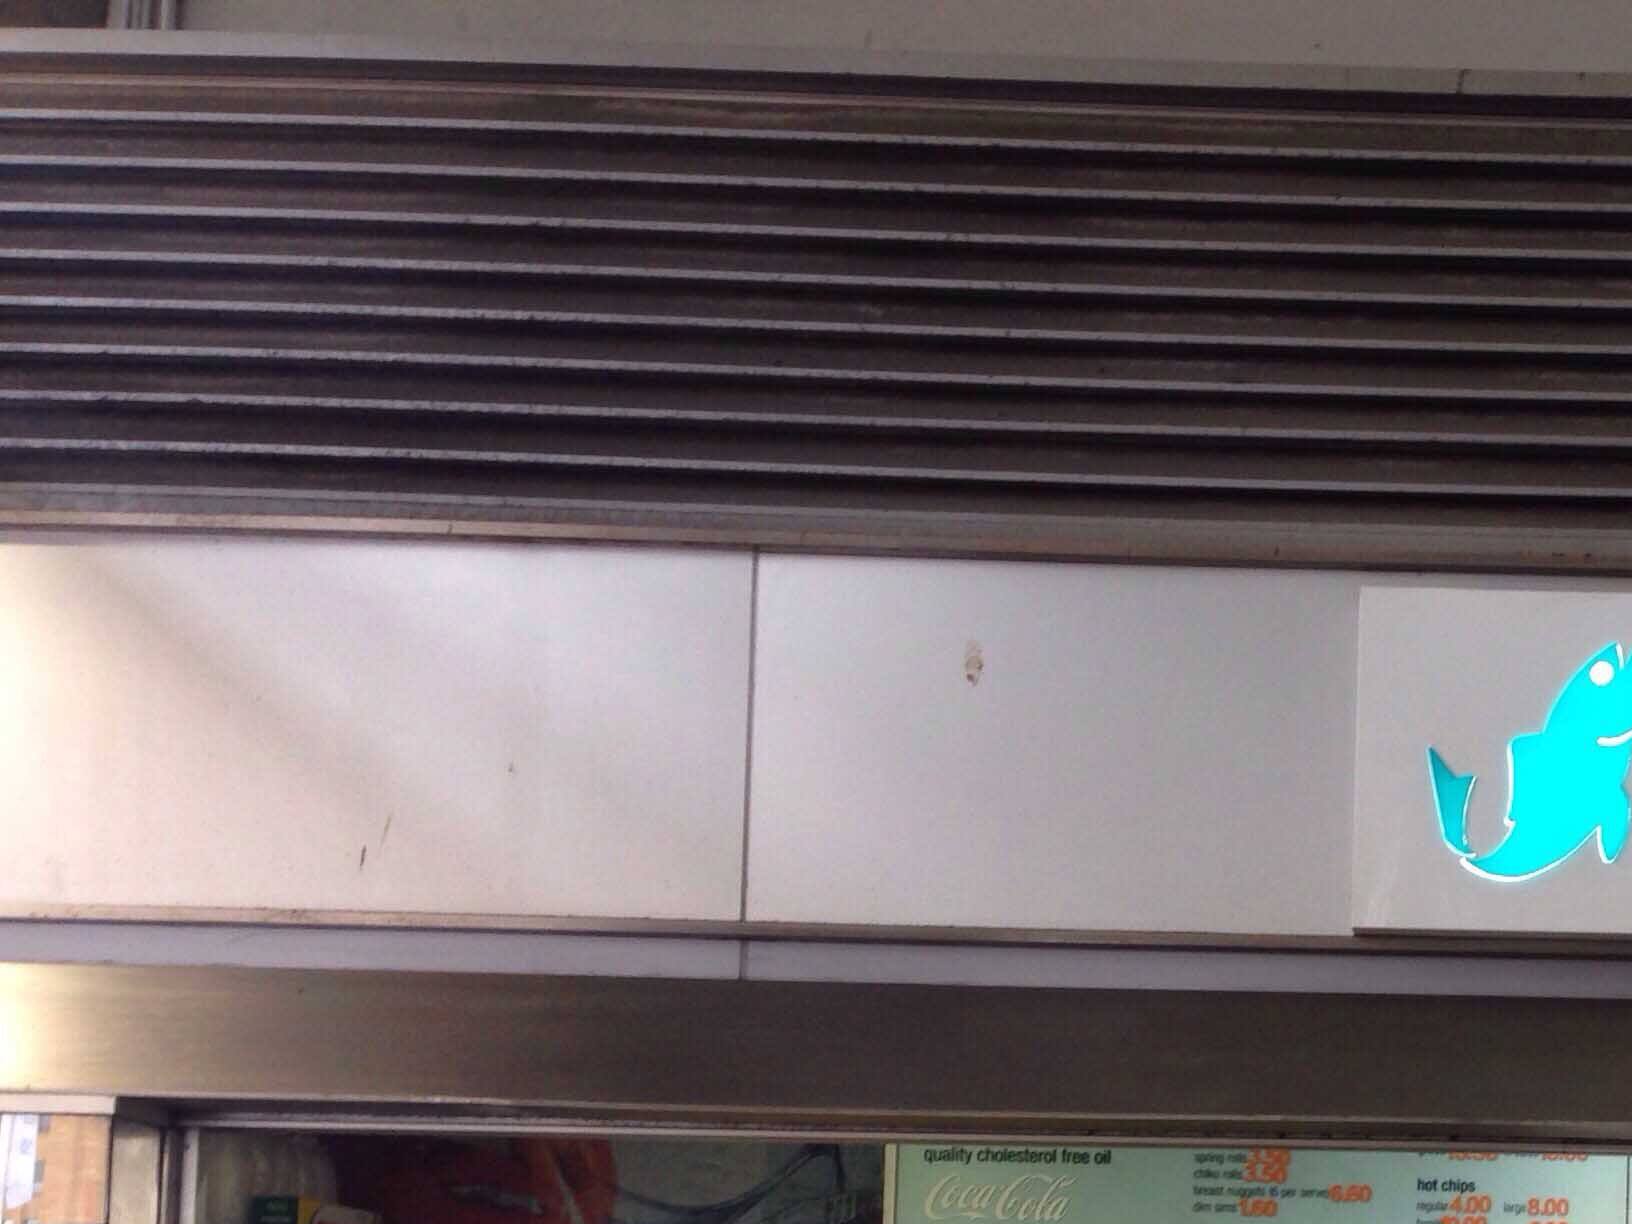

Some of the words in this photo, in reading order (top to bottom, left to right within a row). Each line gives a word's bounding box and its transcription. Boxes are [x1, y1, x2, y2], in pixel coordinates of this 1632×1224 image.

[924, 1149, 972, 1164] quality
[977, 1149, 1056, 1164] cholesterol
[1062, 1150, 1090, 1164] free
[1094, 1149, 1112, 1164] oil
[1417, 1178, 1437, 1192] hot
[1441, 1179, 1476, 1194] chips
[1450, 1195, 1492, 1213] 4.00
[1527, 1198, 1570, 1216] 8.00
